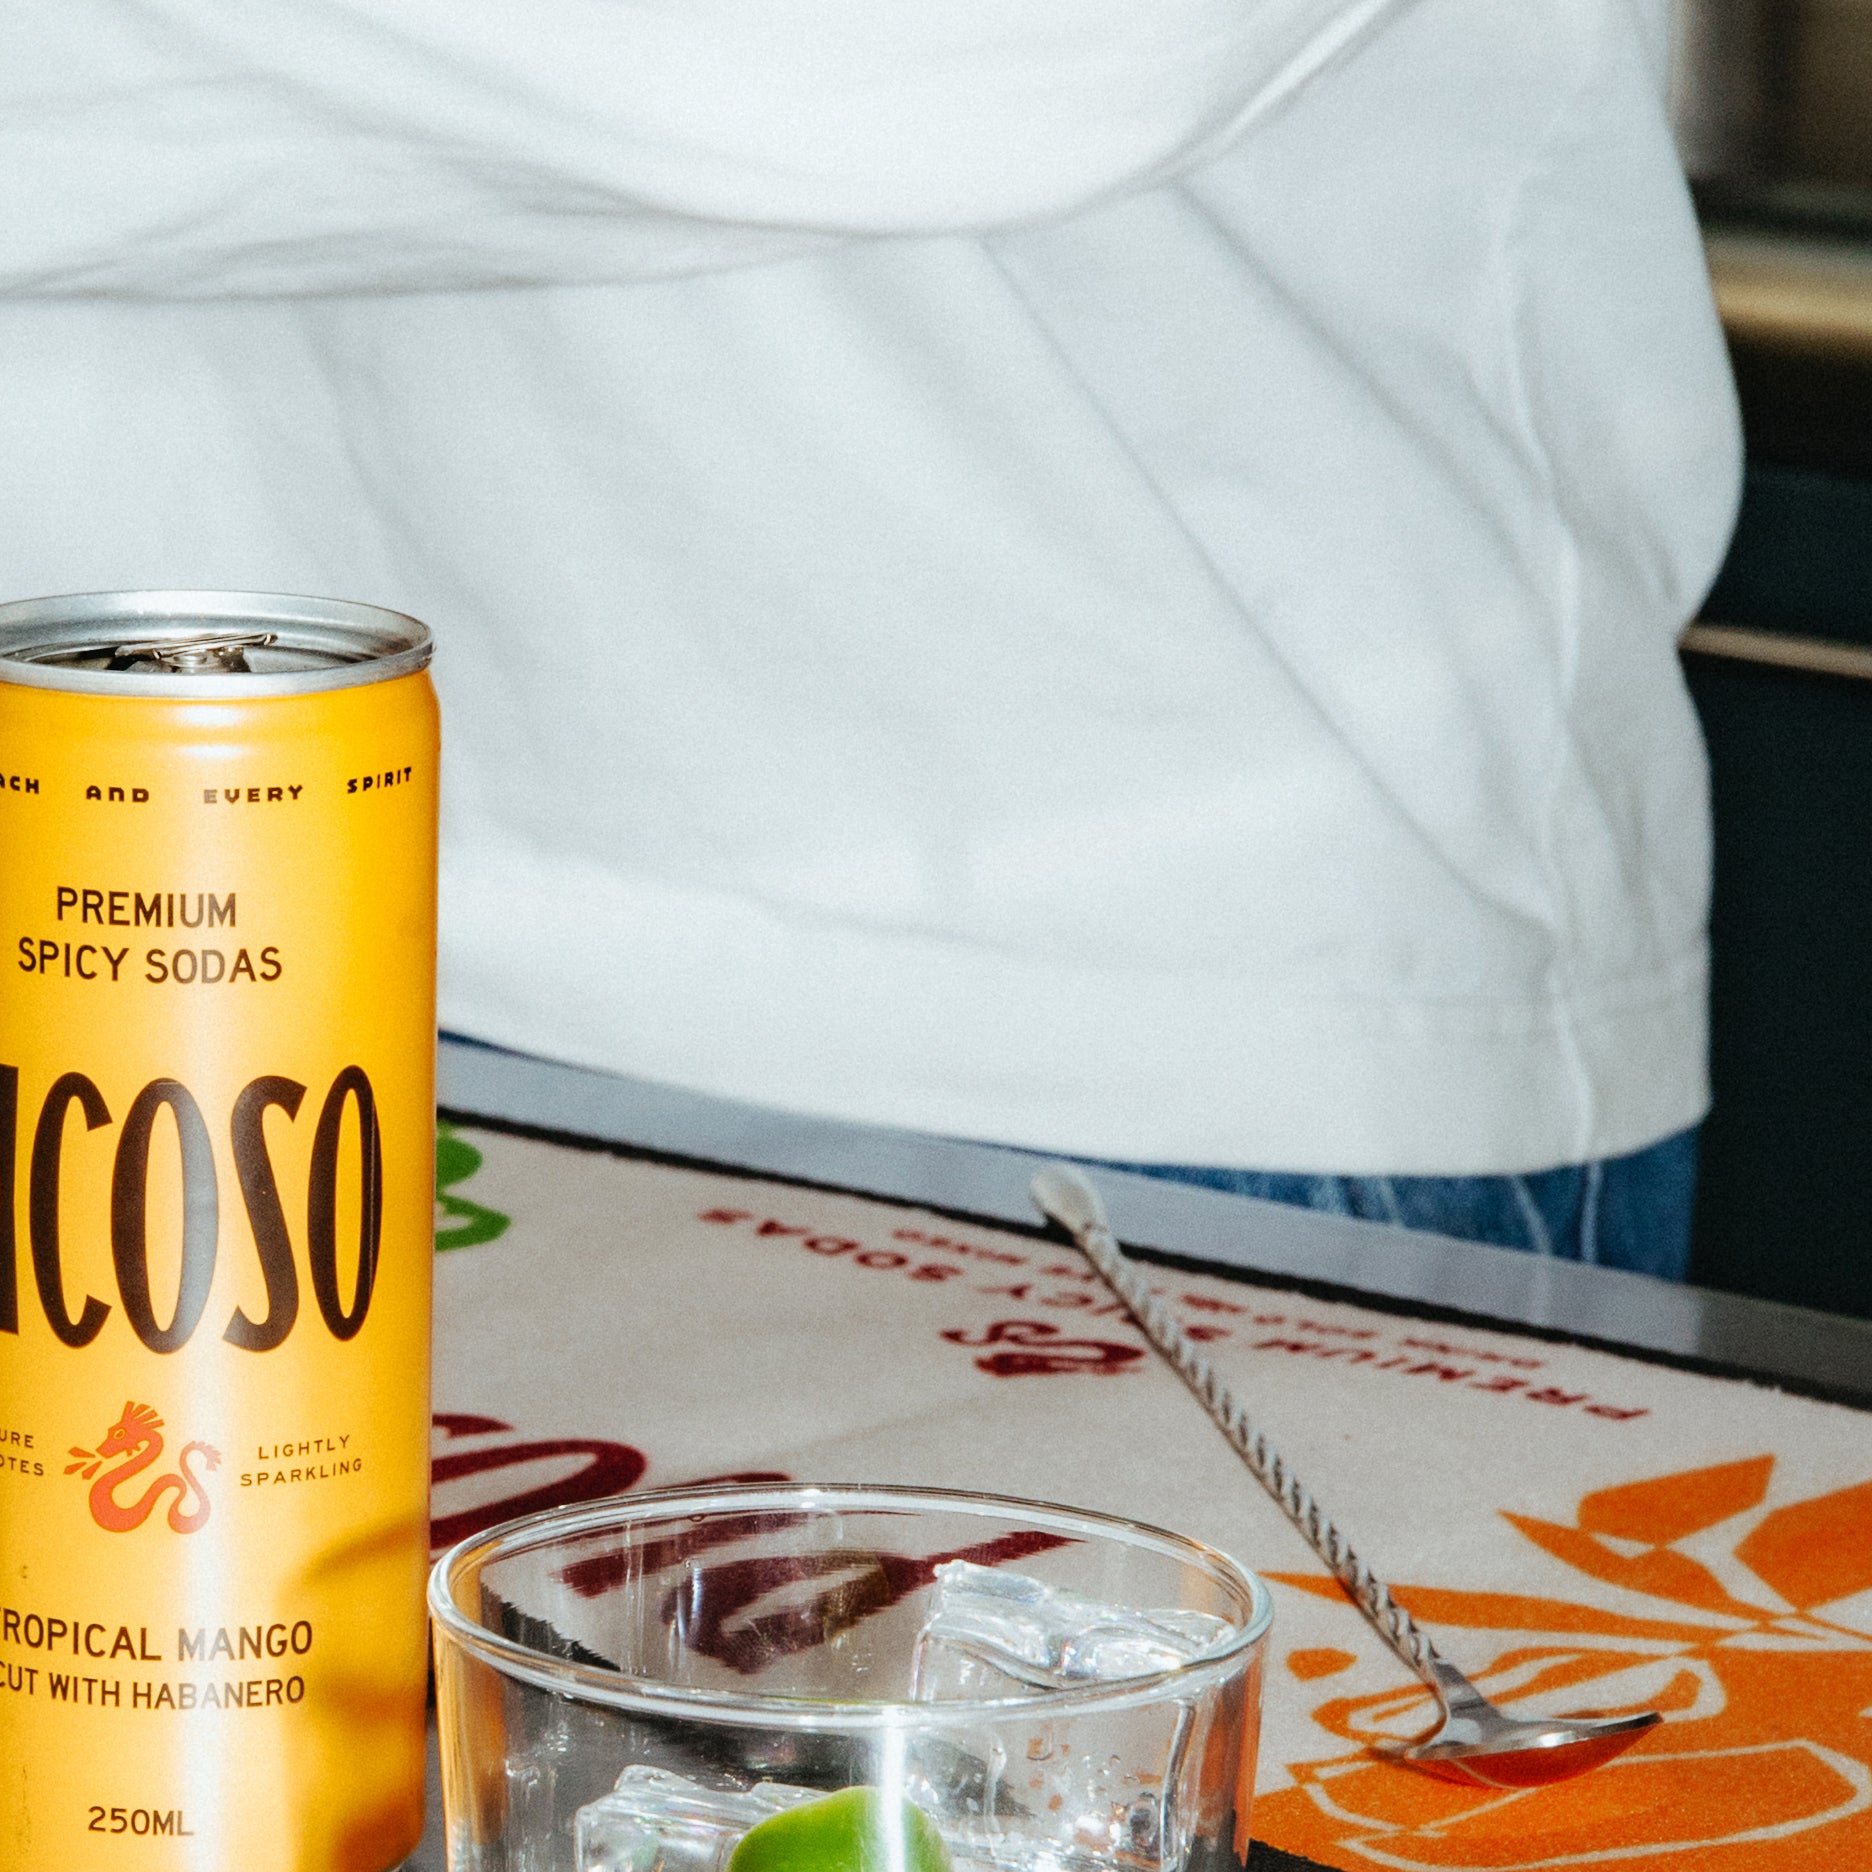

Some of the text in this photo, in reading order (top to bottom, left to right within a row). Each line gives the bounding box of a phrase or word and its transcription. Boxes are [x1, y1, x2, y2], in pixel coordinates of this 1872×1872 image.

[85, 784, 150, 804] AND
[203, 784, 304, 805] EVERY
[346, 765, 414, 795] SPIRIT
[56, 885, 238, 929] PREMIUM
[17, 936, 284, 985] SPICY SODAS
[1249, 1337, 1650, 1424] PREMIUM
[257, 1434, 352, 1461] LIGHTLY
[240, 1457, 364, 1488] SPARKLING
[177, 1619, 313, 1662] MANGO
[49, 1671, 121, 1708] WITH
[132, 1674, 306, 1711] HABANERO
[87, 1805, 195, 1837] 250ML
